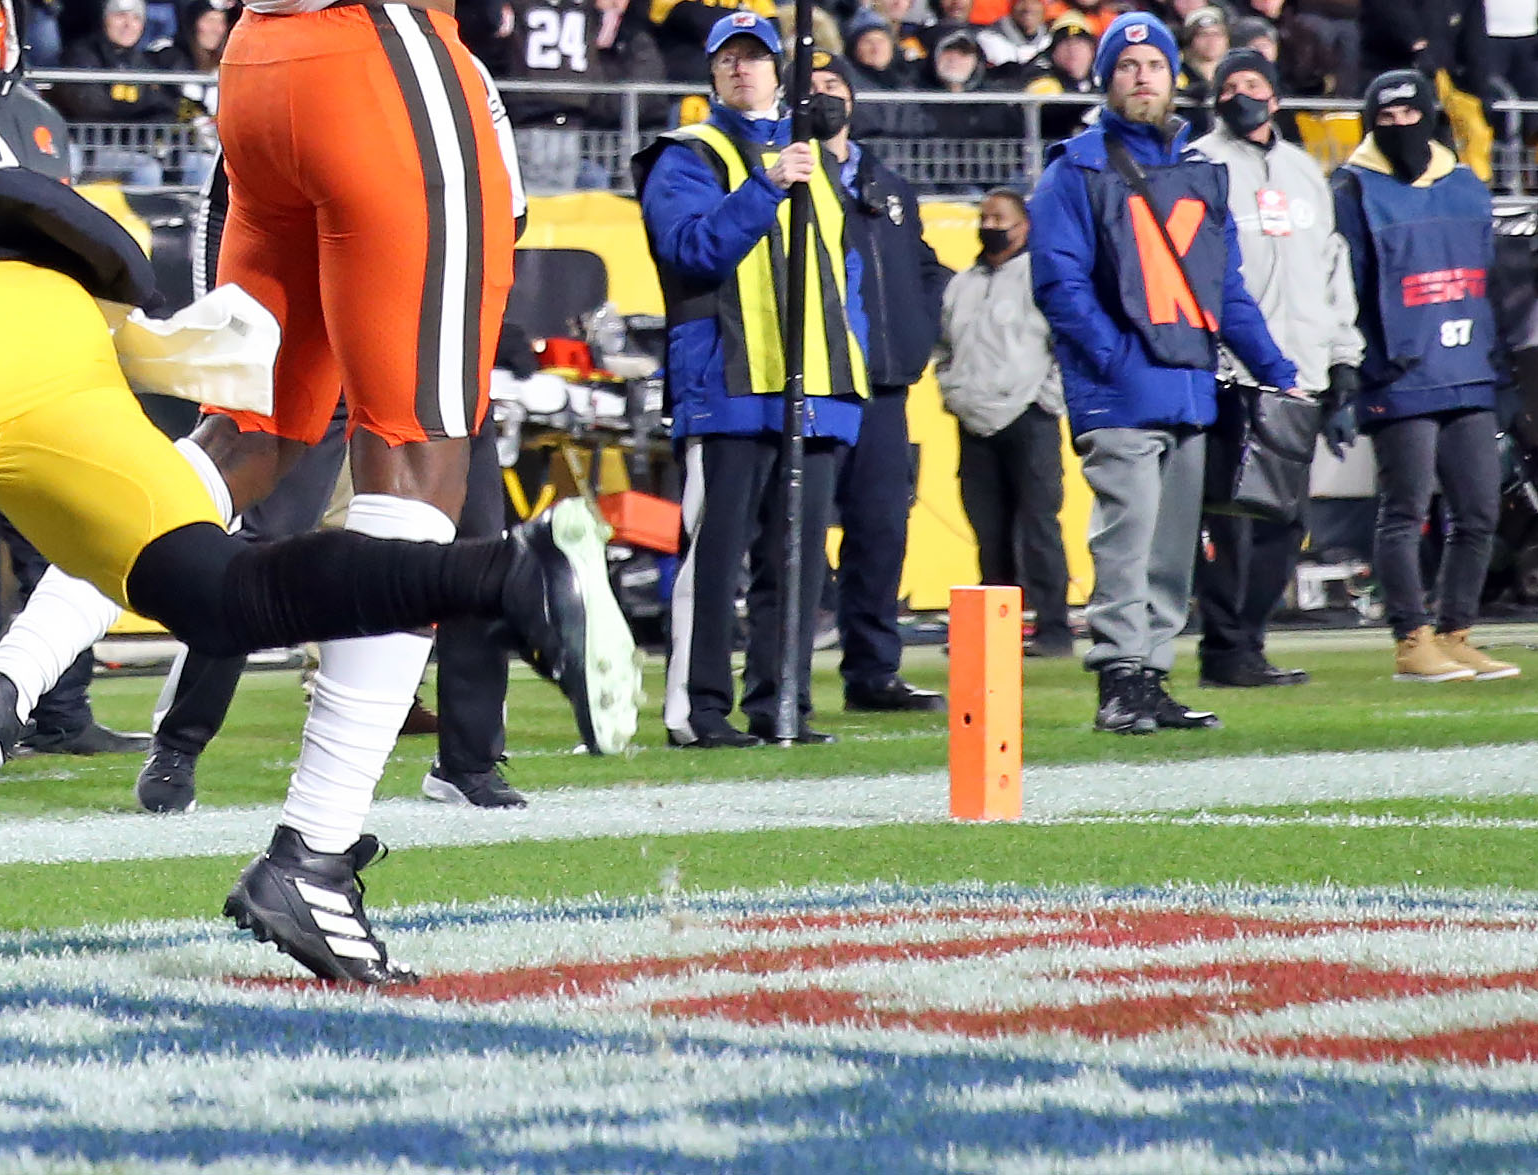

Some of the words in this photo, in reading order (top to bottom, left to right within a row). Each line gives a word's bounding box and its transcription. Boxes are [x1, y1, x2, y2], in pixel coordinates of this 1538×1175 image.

[527, 8, 588, 73] 24
[1128, 194, 1220, 333] K
[1440, 318, 1474, 348] 87
